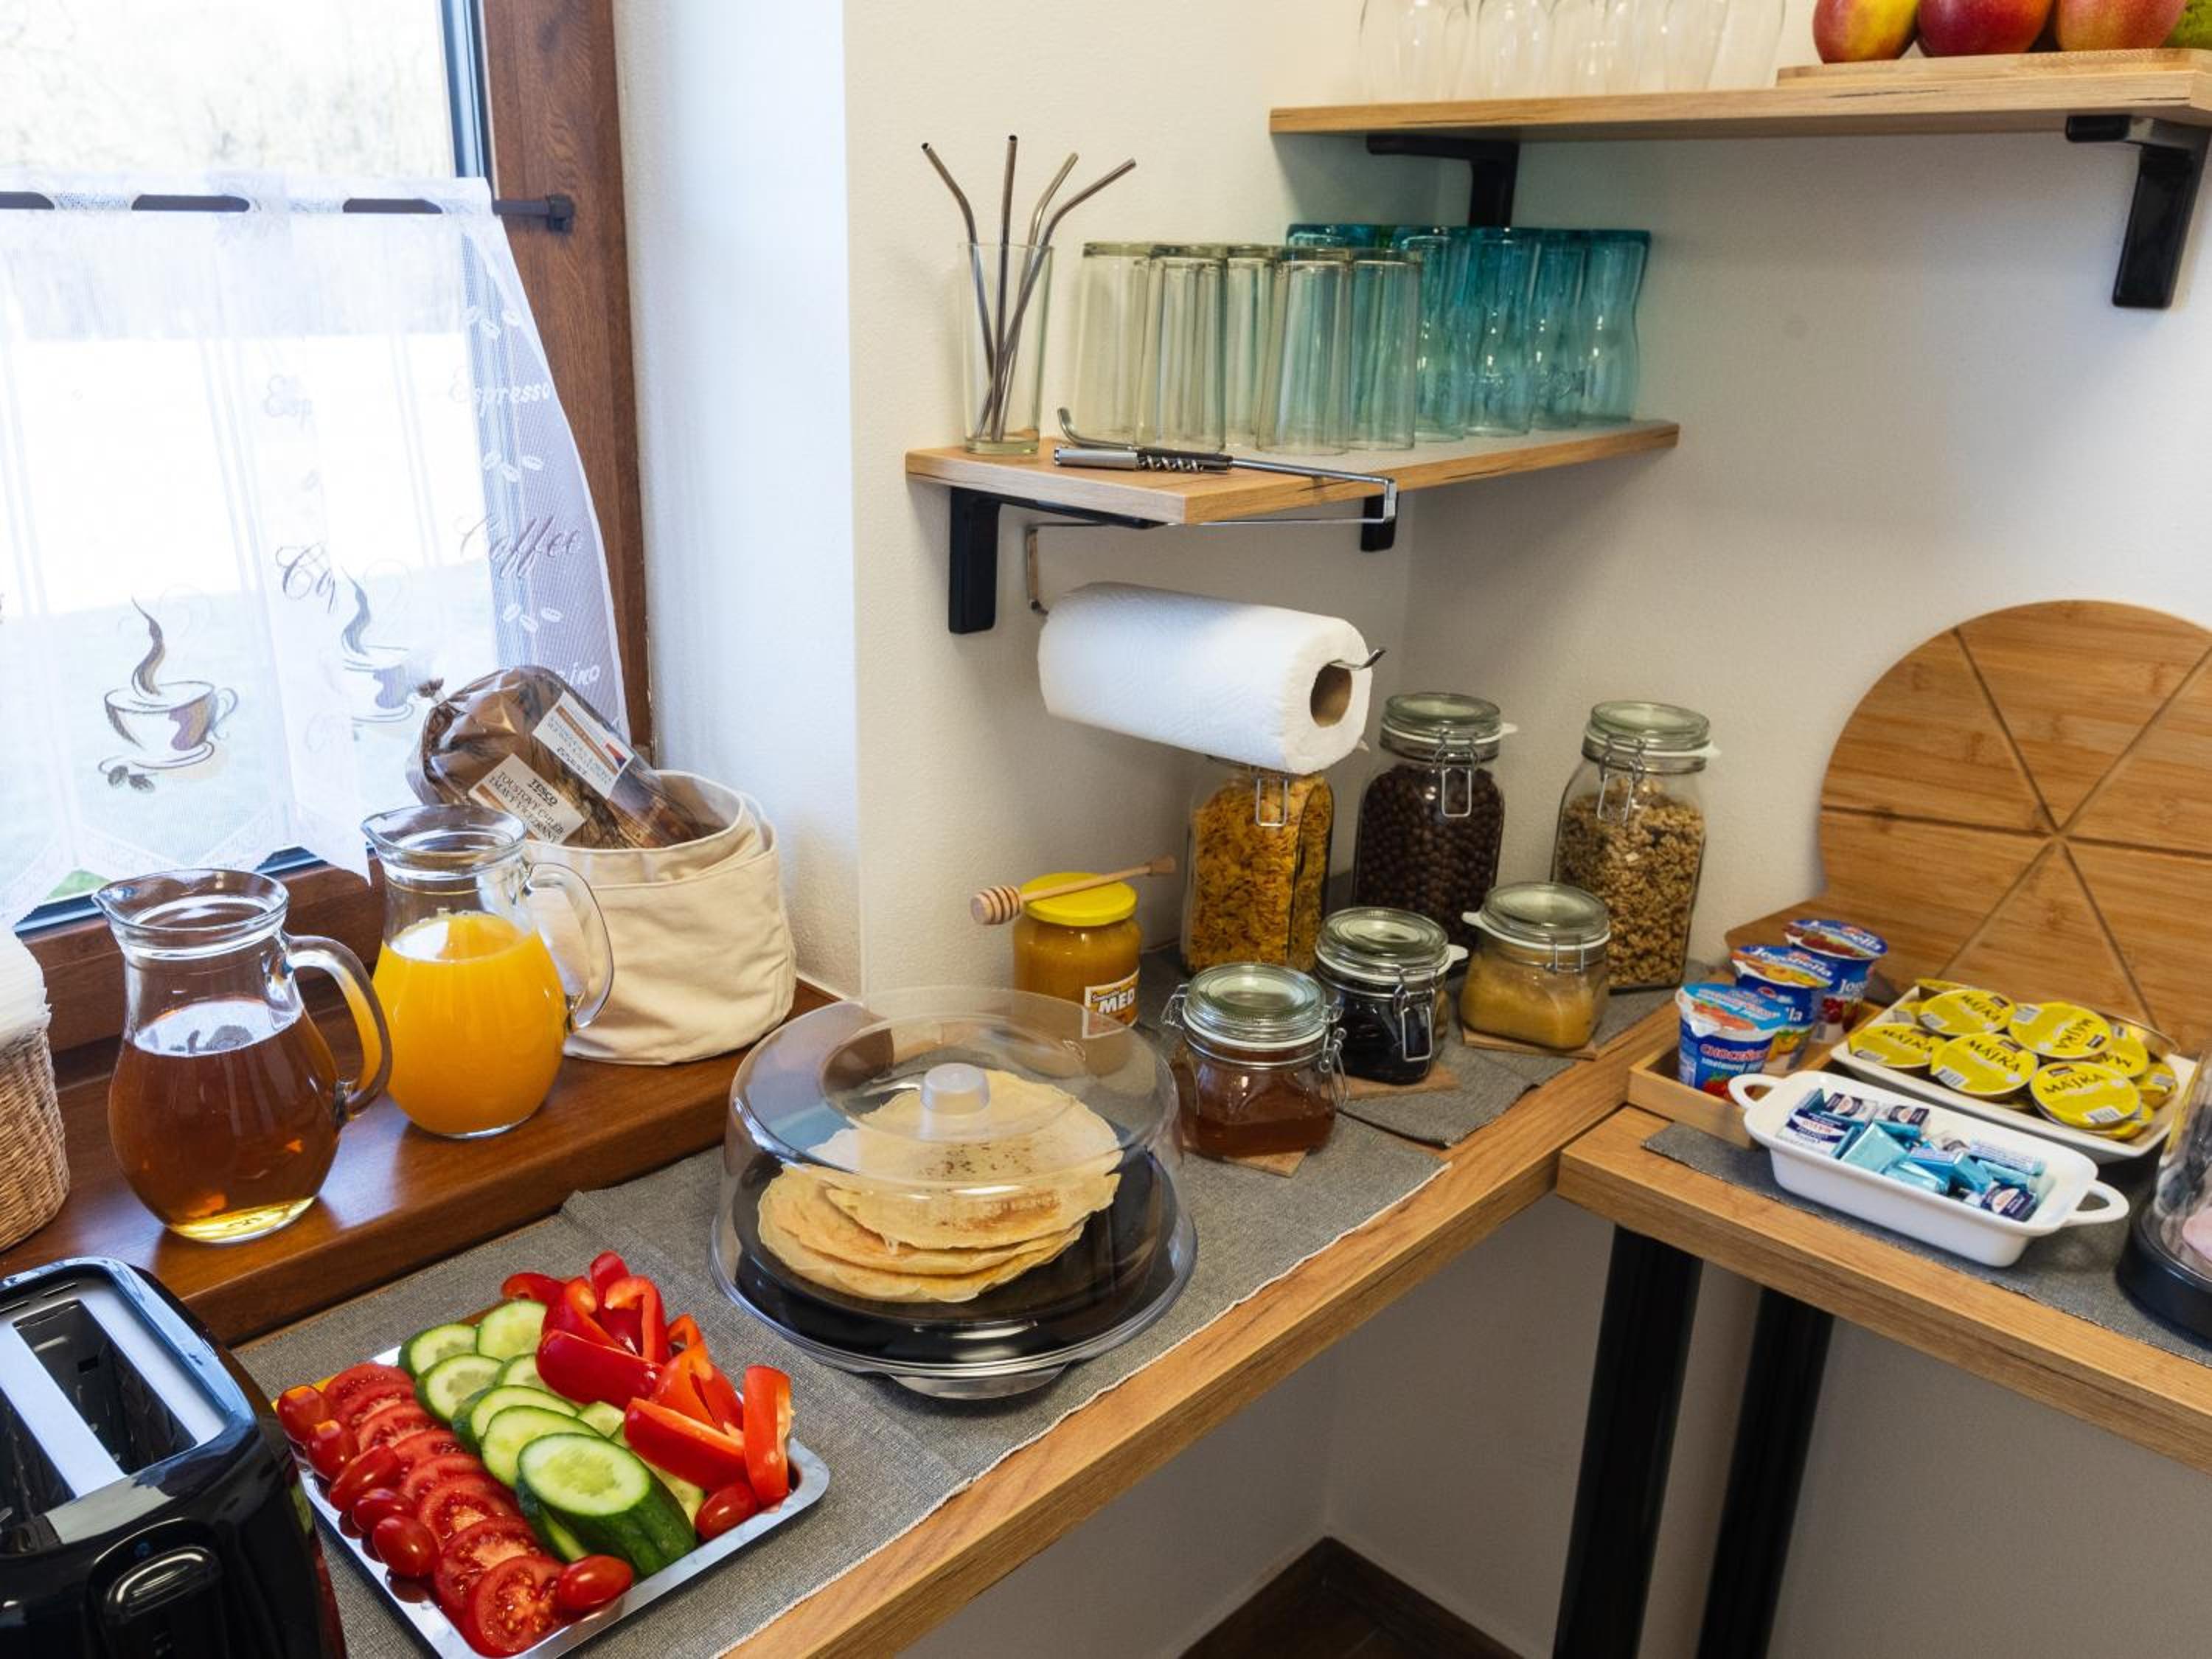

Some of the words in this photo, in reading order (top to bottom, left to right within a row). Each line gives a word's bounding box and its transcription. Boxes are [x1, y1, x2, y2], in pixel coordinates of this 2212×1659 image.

[455, 515, 582, 579] Coffee
[529, 778, 559, 807] TESCO
[1098, 986, 1135, 1015] MED
